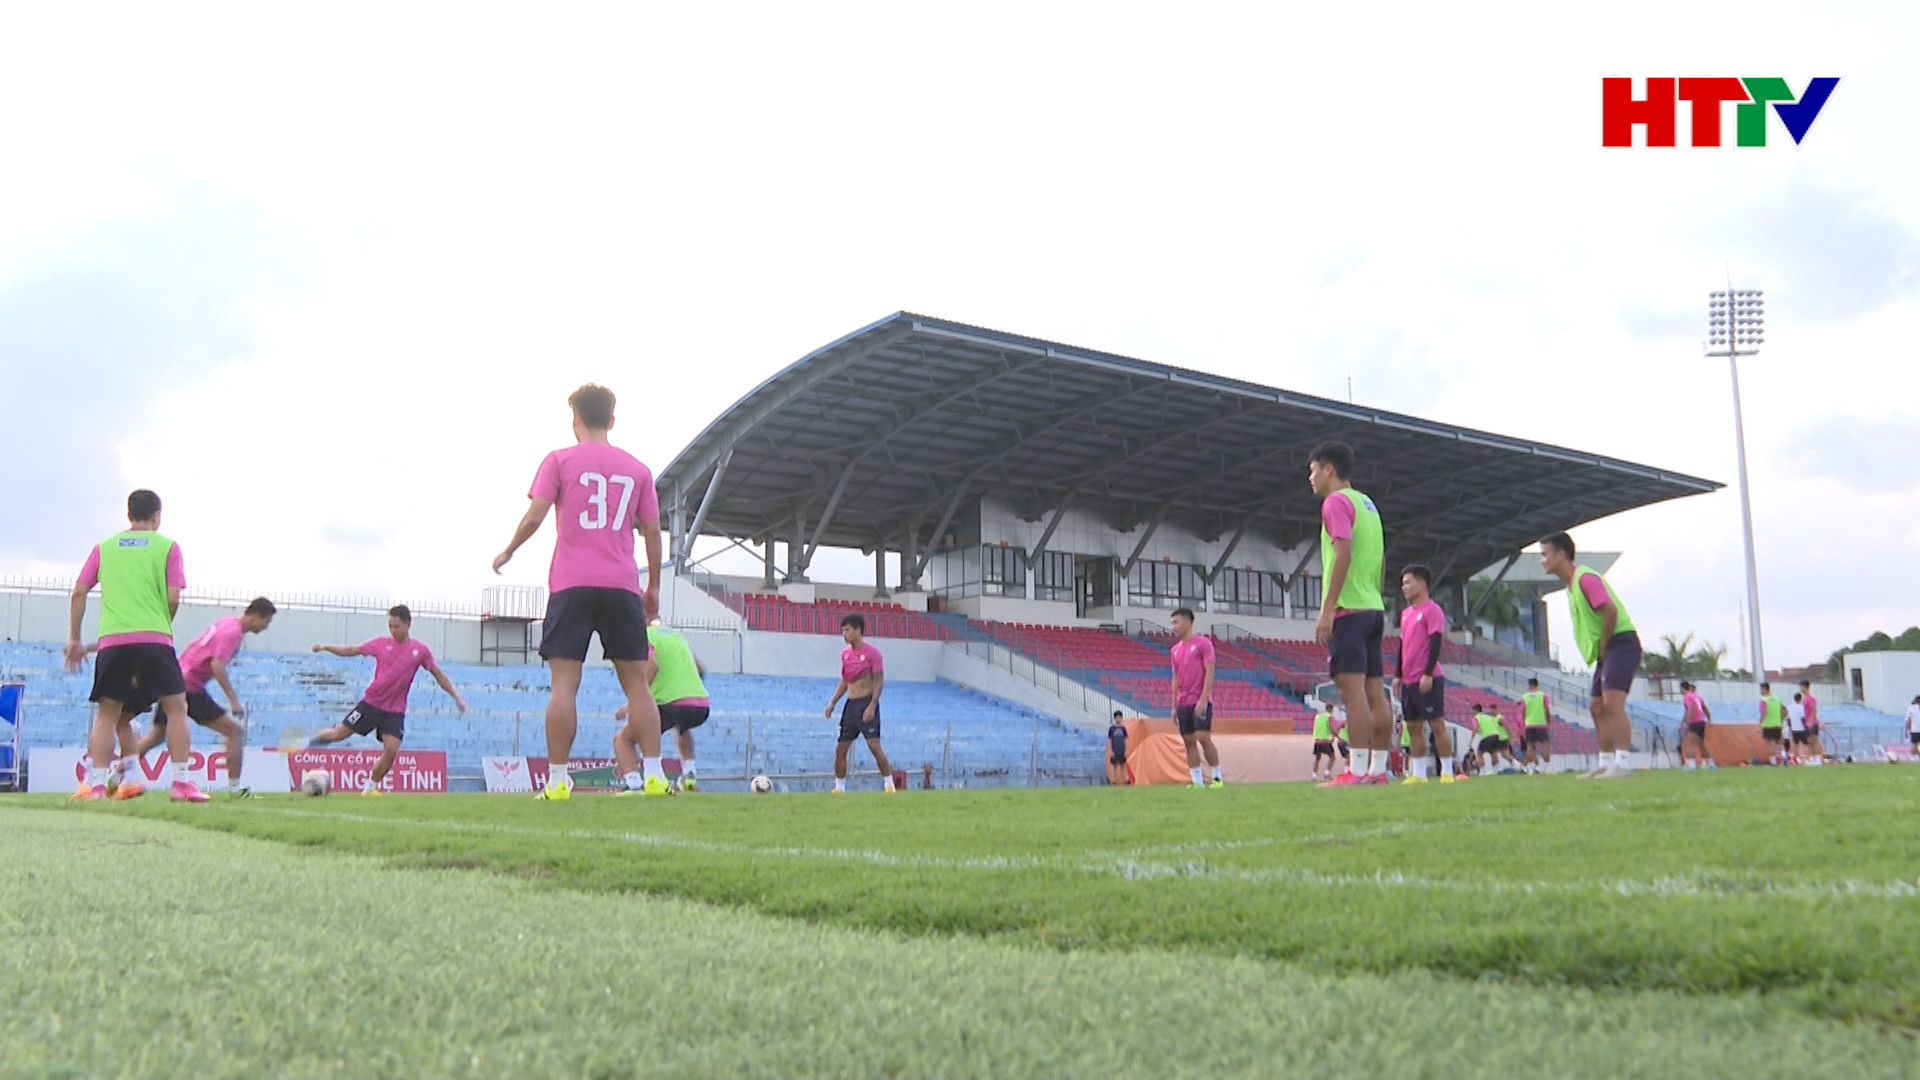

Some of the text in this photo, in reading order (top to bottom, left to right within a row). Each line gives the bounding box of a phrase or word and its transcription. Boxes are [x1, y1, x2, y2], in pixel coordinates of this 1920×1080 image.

[579, 472, 635, 531] 37
[294, 752, 327, 764] CÔNG
[330, 754, 344, 764] TY
[399, 756, 416, 765] BIA
[399, 766, 442, 789] TĨNH
